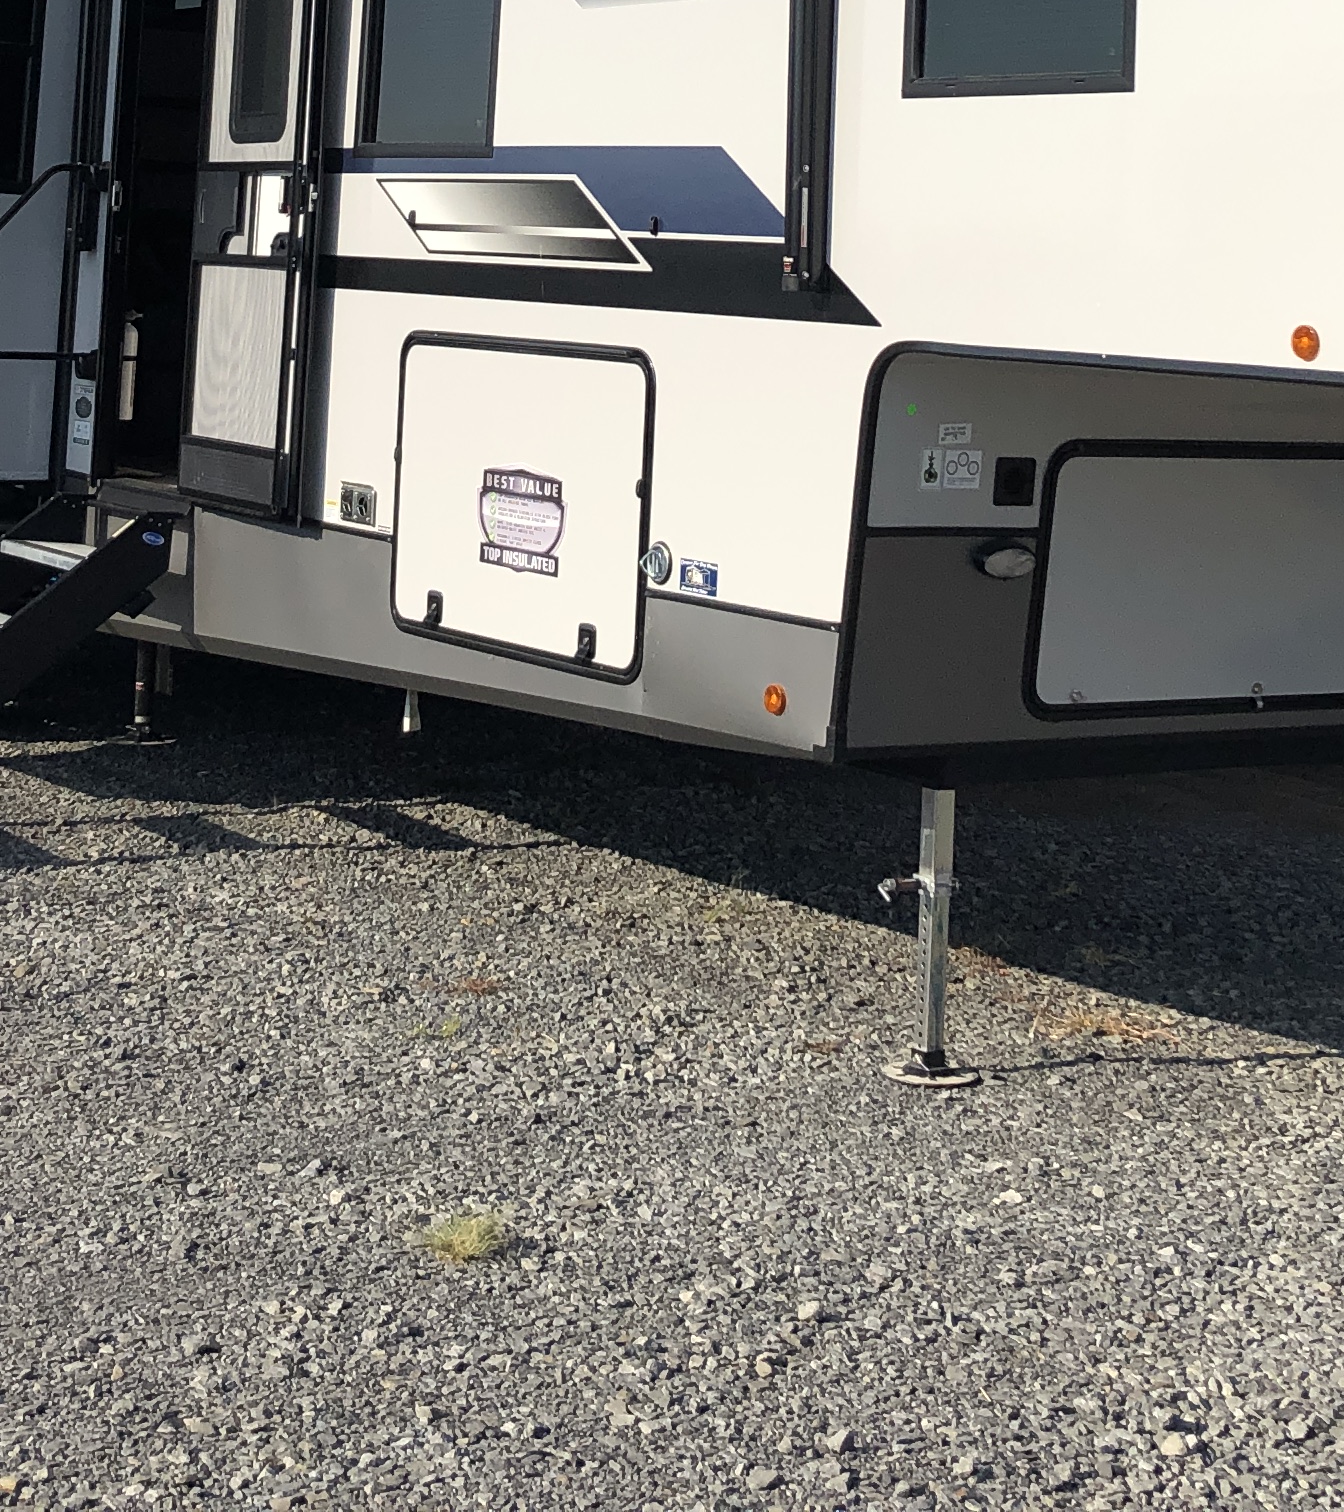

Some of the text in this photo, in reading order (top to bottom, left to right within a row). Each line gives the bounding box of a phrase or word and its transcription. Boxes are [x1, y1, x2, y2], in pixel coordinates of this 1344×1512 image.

[486, 473, 559, 498] BEST VALUE
[483, 546, 555, 573] TOP INSULATED
